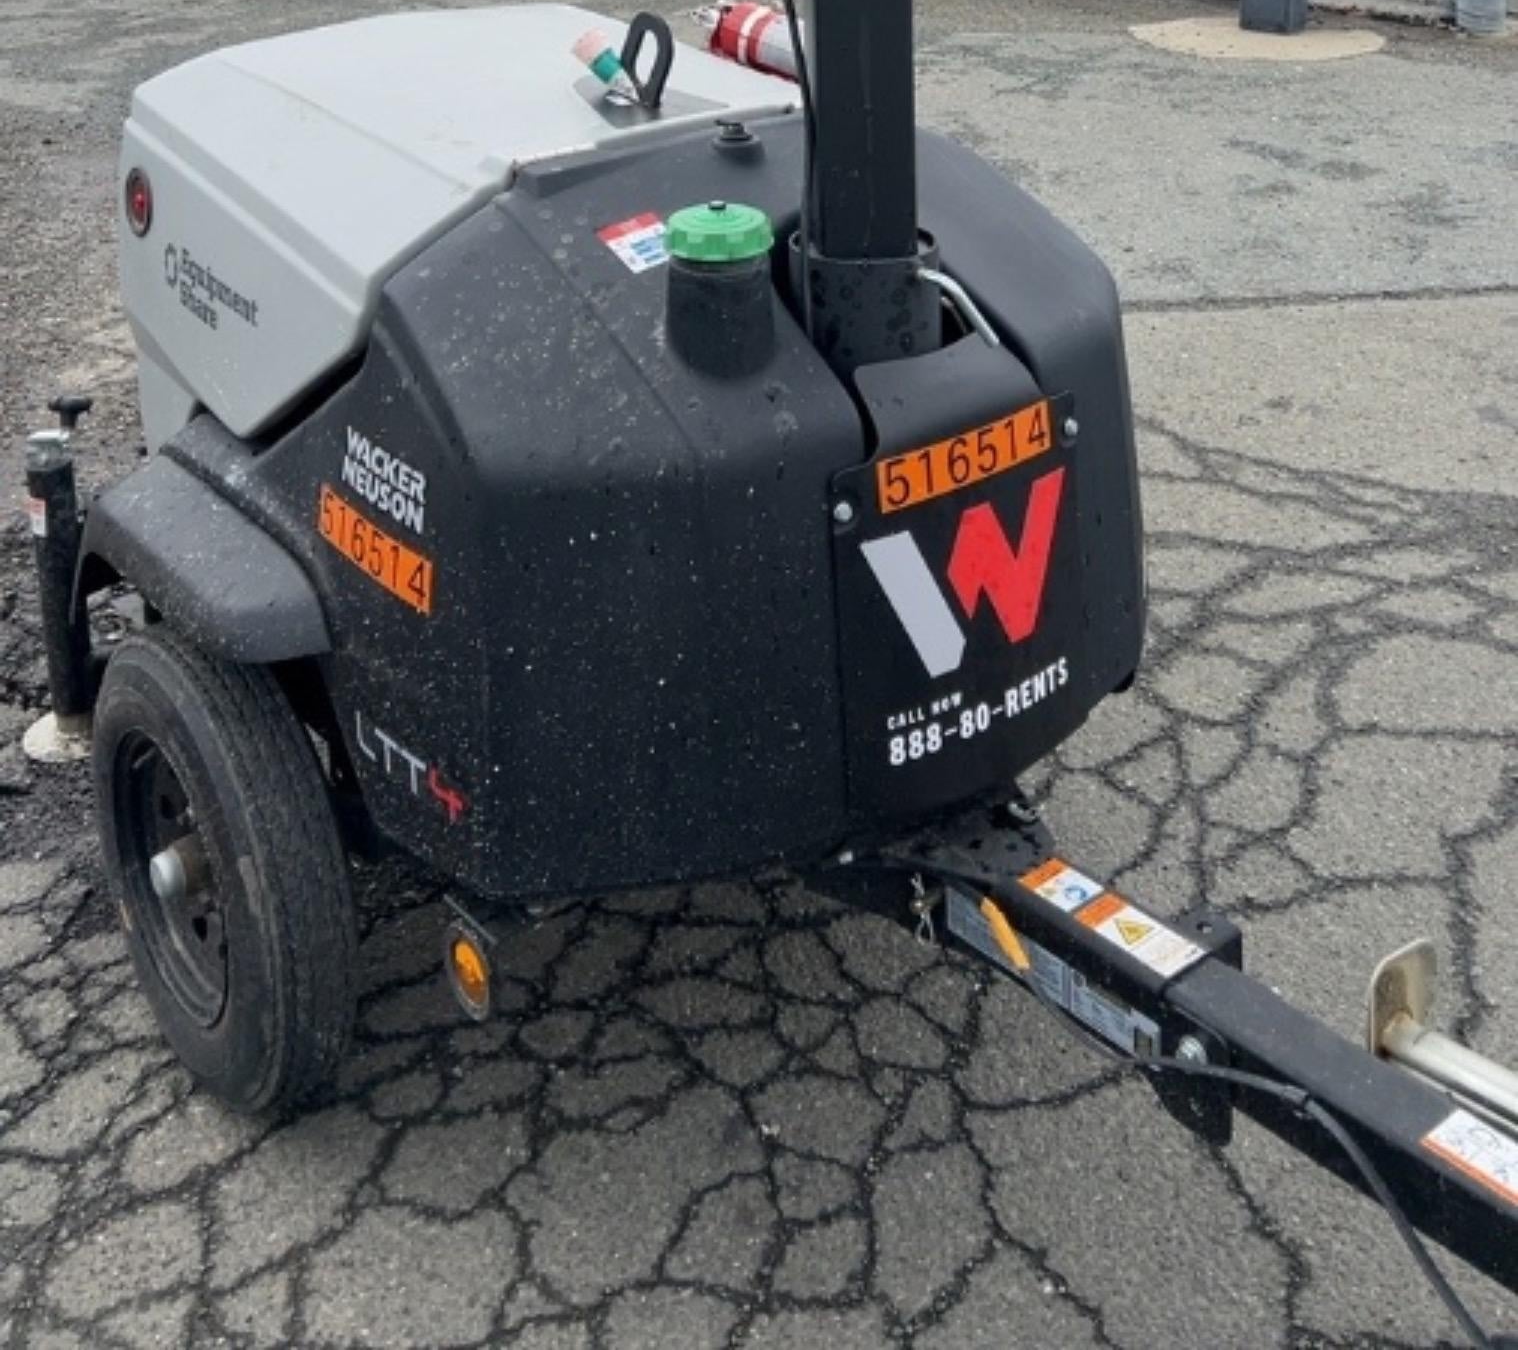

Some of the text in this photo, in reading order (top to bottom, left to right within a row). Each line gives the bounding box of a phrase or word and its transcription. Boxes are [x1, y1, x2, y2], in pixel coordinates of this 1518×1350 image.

[180, 280, 217, 330] Share
[181, 248, 258, 327] Equipment
[341, 454, 425, 535] NEUSON
[345, 425, 428, 504] WACKER
[885, 406, 1047, 506] 516514
[322, 490, 428, 604] 516514
[887, 691, 963, 731] CALL NOW
[889, 656, 1069, 766] 888-80-RENTS
[355, 710, 464, 823] LTT4
